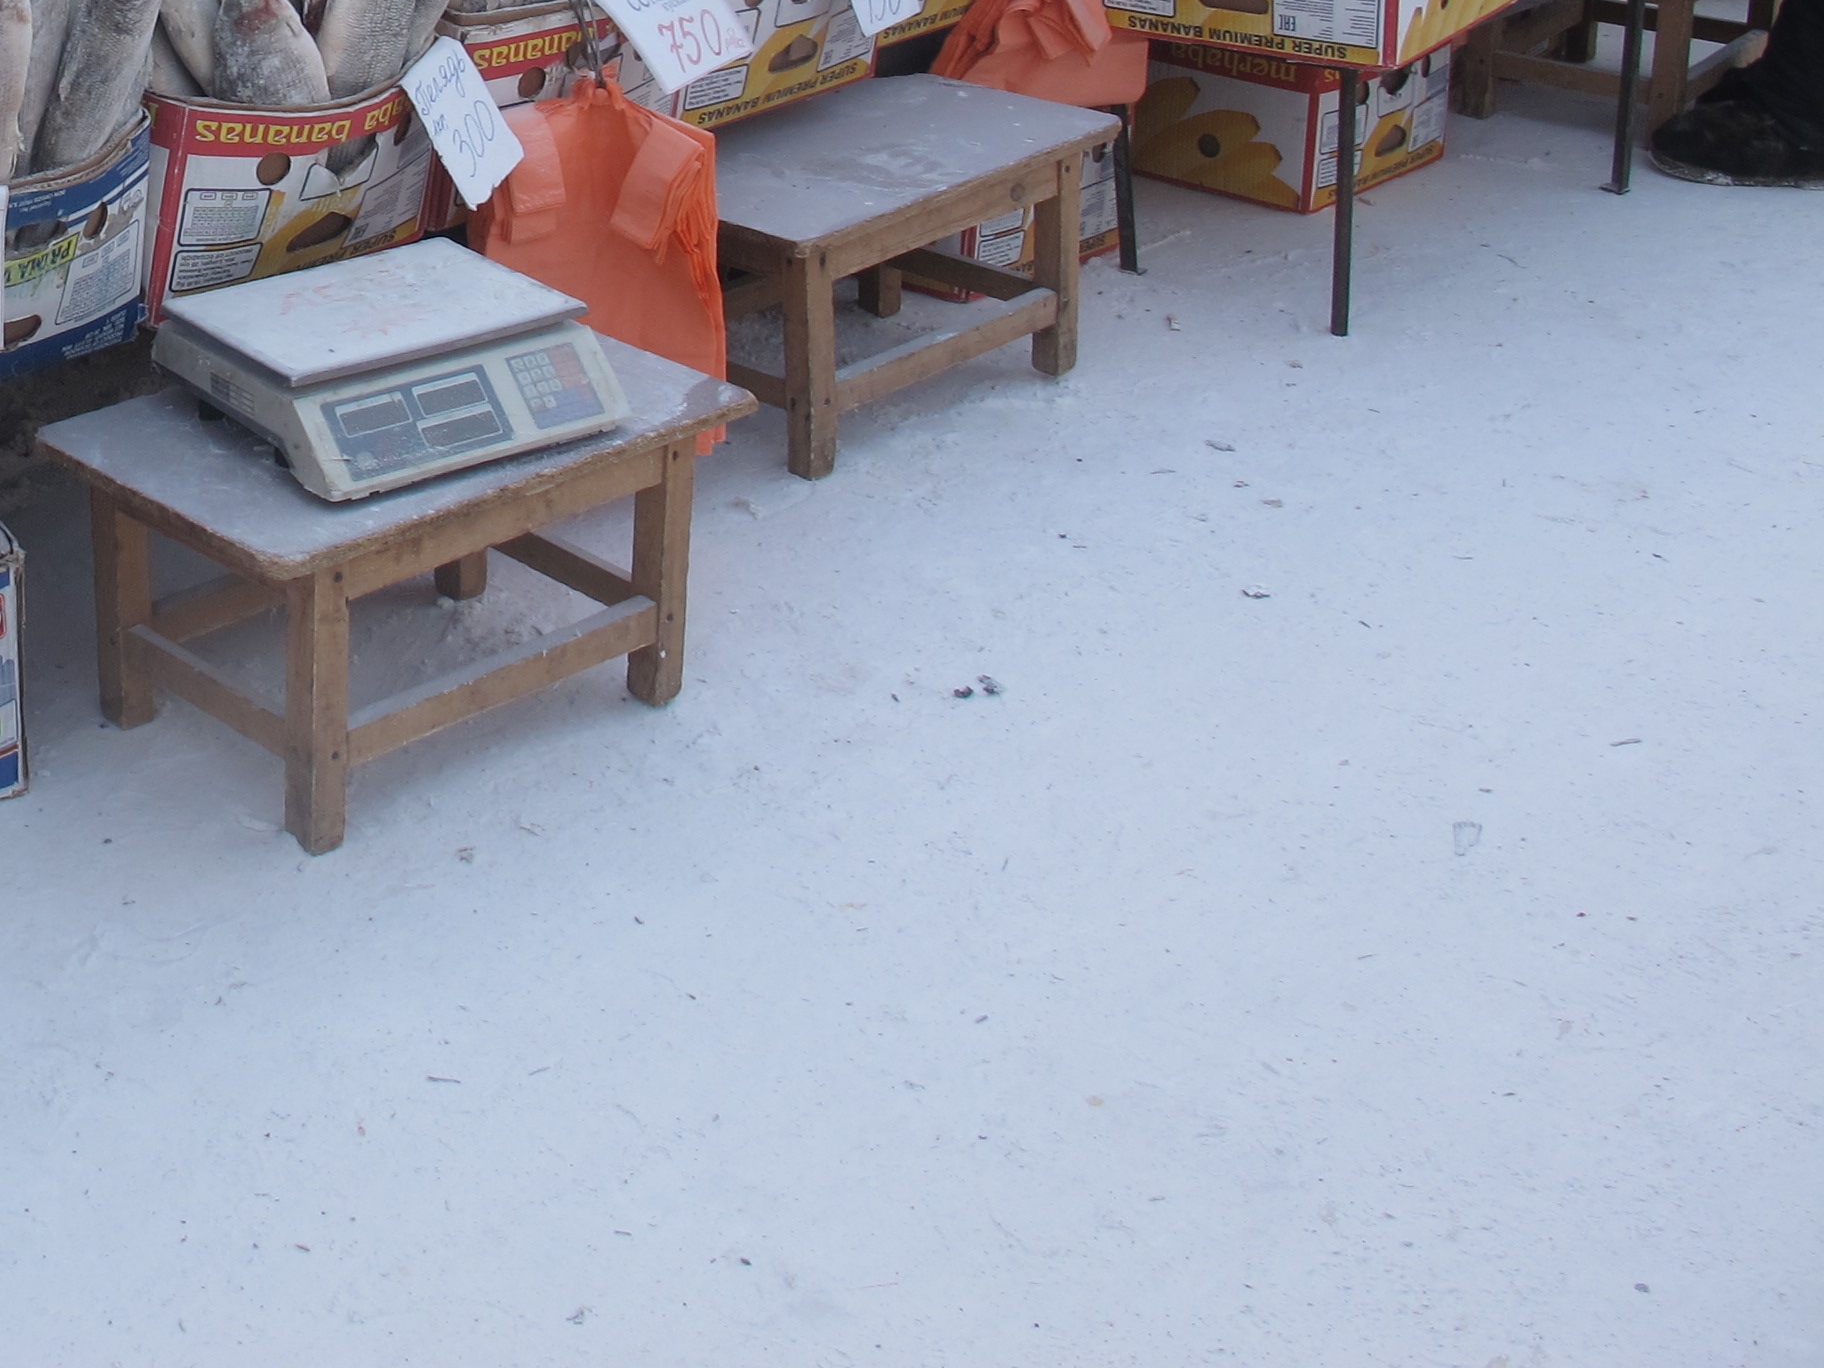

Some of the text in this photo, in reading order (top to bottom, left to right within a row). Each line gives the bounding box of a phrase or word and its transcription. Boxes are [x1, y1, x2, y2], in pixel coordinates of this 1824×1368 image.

[657, 8, 722, 73] 750
[1128, 15, 1348, 59] SUPER PREMIUM BANANAS
[819, 61, 858, 86] SUPER
[762, 76, 817, 105] PREMIUM
[697, 95, 761, 126] BANANAS
[195, 117, 353, 146] bananas
[452, 100, 495, 178] 300
